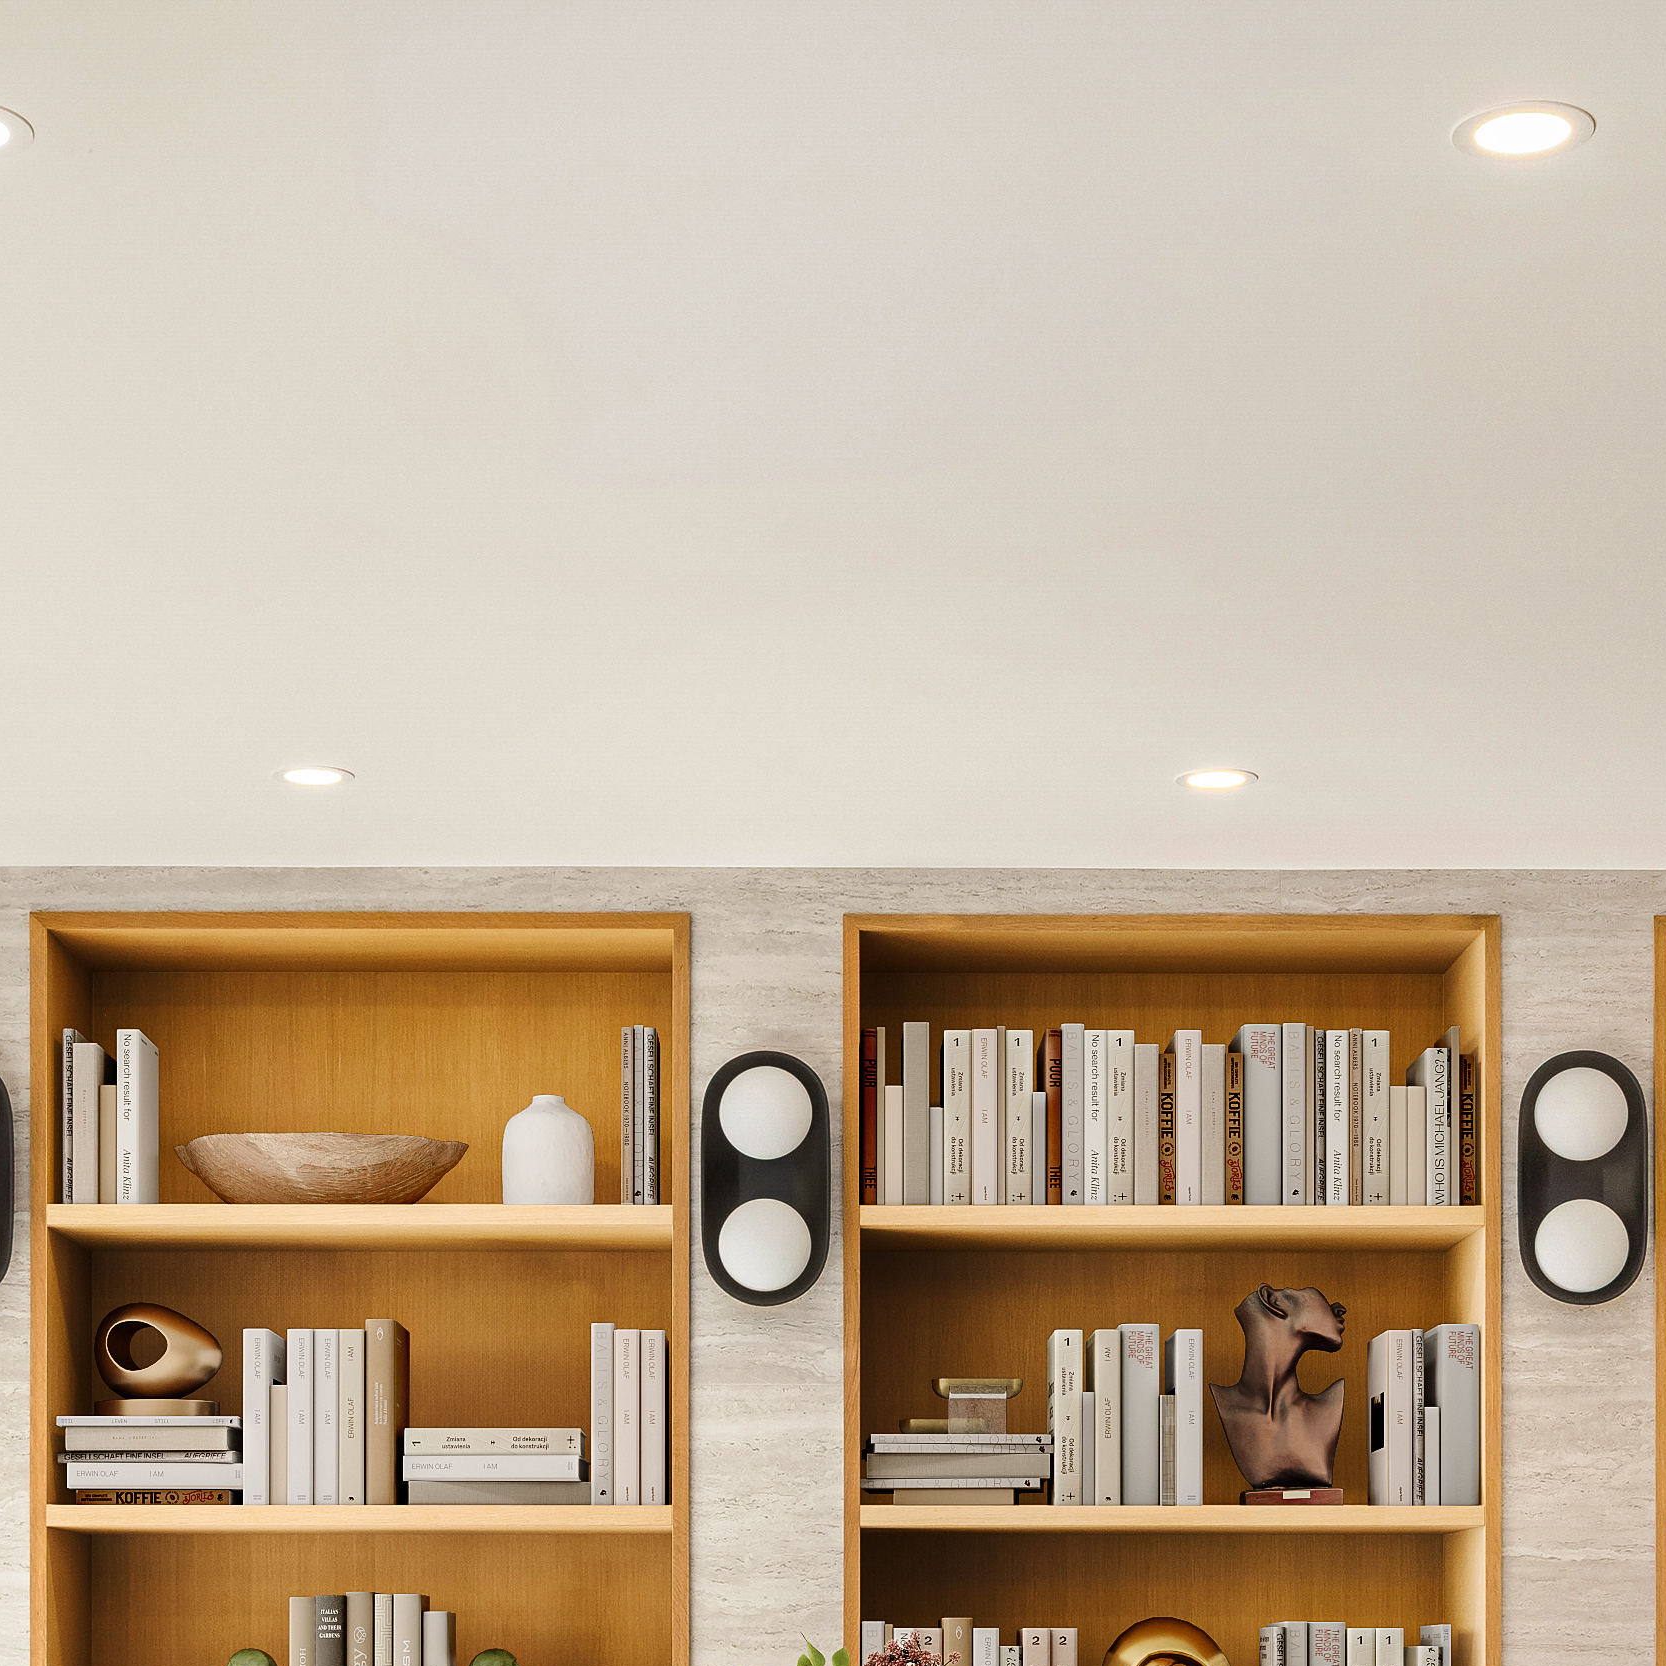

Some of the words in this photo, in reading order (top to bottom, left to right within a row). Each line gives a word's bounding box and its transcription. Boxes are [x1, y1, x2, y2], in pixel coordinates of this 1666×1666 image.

[123, 1034, 132, 1047] No
[1091, 1034, 1100, 1048] No
[123, 1048, 132, 1079] search
[1091, 1049, 1100, 1080] search
[1435, 1060, 1444, 1098] JANG?
[123, 1081, 132, 1106] result
[1091, 1081, 1100, 1107] result
[123, 1108, 132, 1121] for
[1091, 1109, 1100, 1122] for
[1435, 1100, 1444, 1155] MICHAEL
[122, 1149, 132, 1174] Anita
[1091, 1149, 1100, 1175] Anita
[1435, 1159, 1444, 1169] IS
[122, 1176, 132, 1201] Klinz
[1049, 1164, 1061, 1190] THEE
[1090, 1176, 1100, 1201] Klinz
[1435, 1173, 1444, 1206] WHO
[1448, 1331, 1457, 1359] FUTURE
[1456, 1330, 1466, 1354] MINDS
[1465, 1330, 1474, 1346] THE
[1456, 1354, 1466, 1365] OF
[1465, 1346, 1474, 1370] GREAT
[114, 1491, 162, 1504] KOFFIE
[1031, 1635, 1040, 1646] 2
[1356, 1635, 1363, 1645] 1
